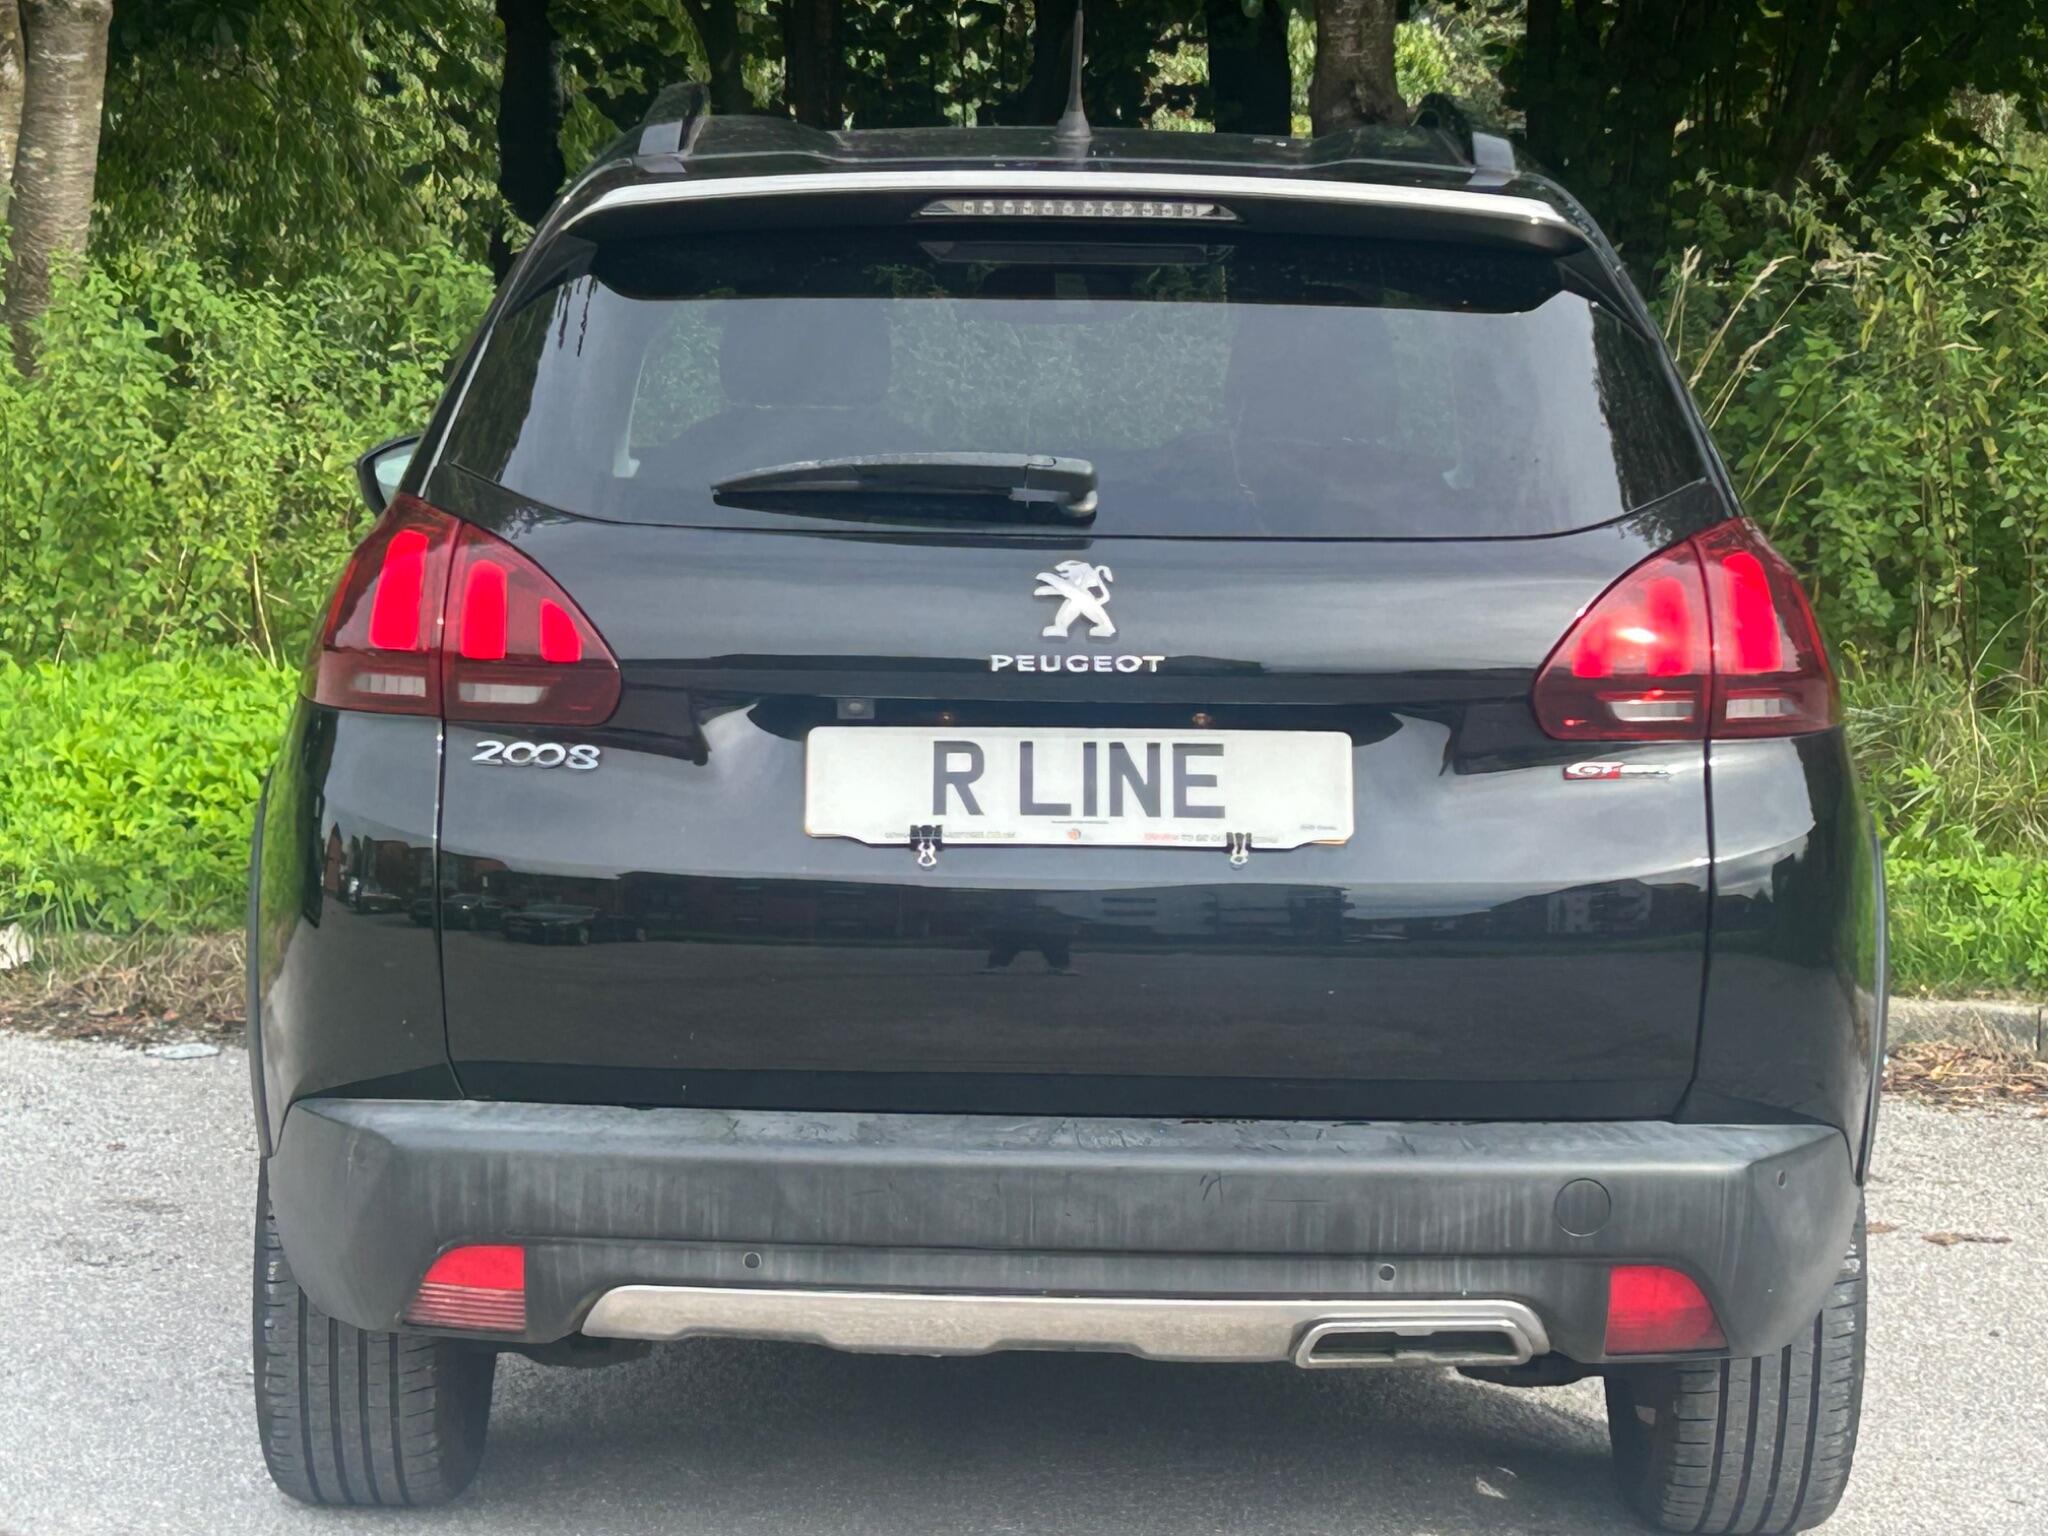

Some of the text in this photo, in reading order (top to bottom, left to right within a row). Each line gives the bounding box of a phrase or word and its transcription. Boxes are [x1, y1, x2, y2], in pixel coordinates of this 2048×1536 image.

[989, 654, 1165, 673] PEUGEOT
[471, 740, 601, 770] 2008
[933, 740, 1225, 818] R LINE
